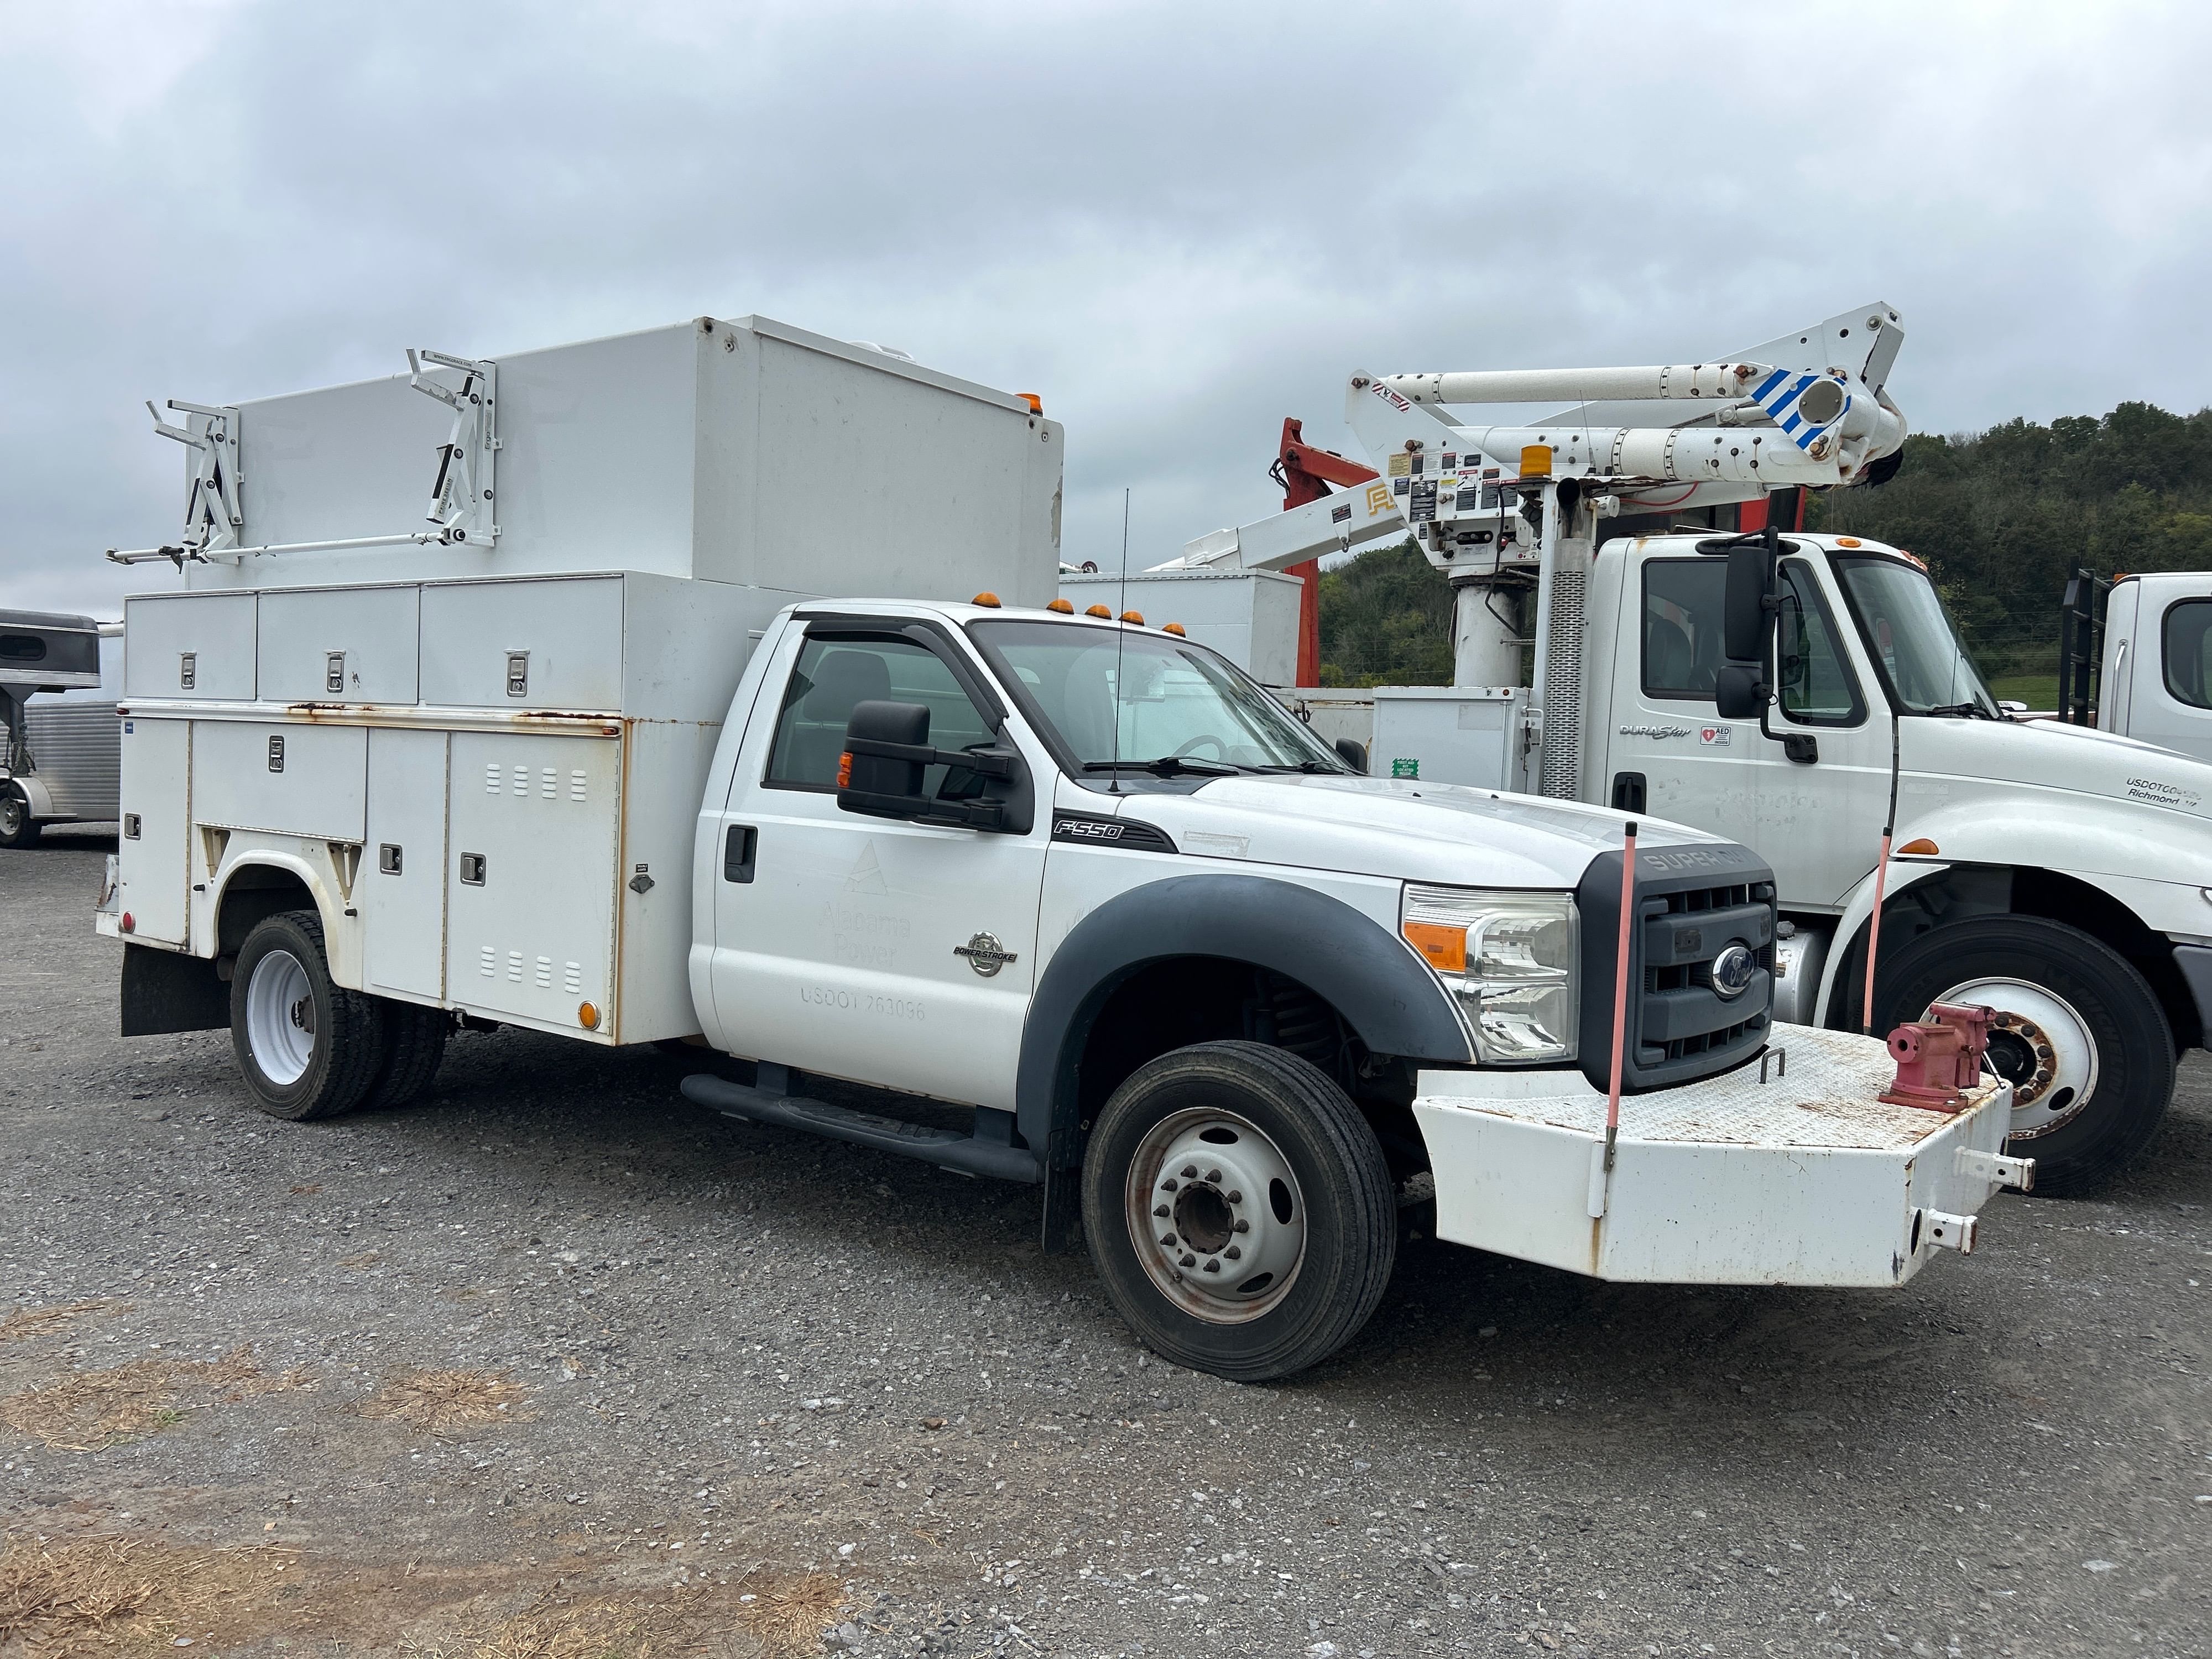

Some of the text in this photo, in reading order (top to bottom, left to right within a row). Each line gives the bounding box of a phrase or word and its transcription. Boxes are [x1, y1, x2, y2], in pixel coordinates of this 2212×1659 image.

[2128, 788, 2180, 805] Richmond
[1053, 820, 1125, 840] F-550
[1643, 851, 1722, 872] SUPER
[953, 946, 1017, 961] POWER STROKE
[1730, 955, 1754, 985] Ford
[2074, 987, 2125, 1095] MICHELIN
